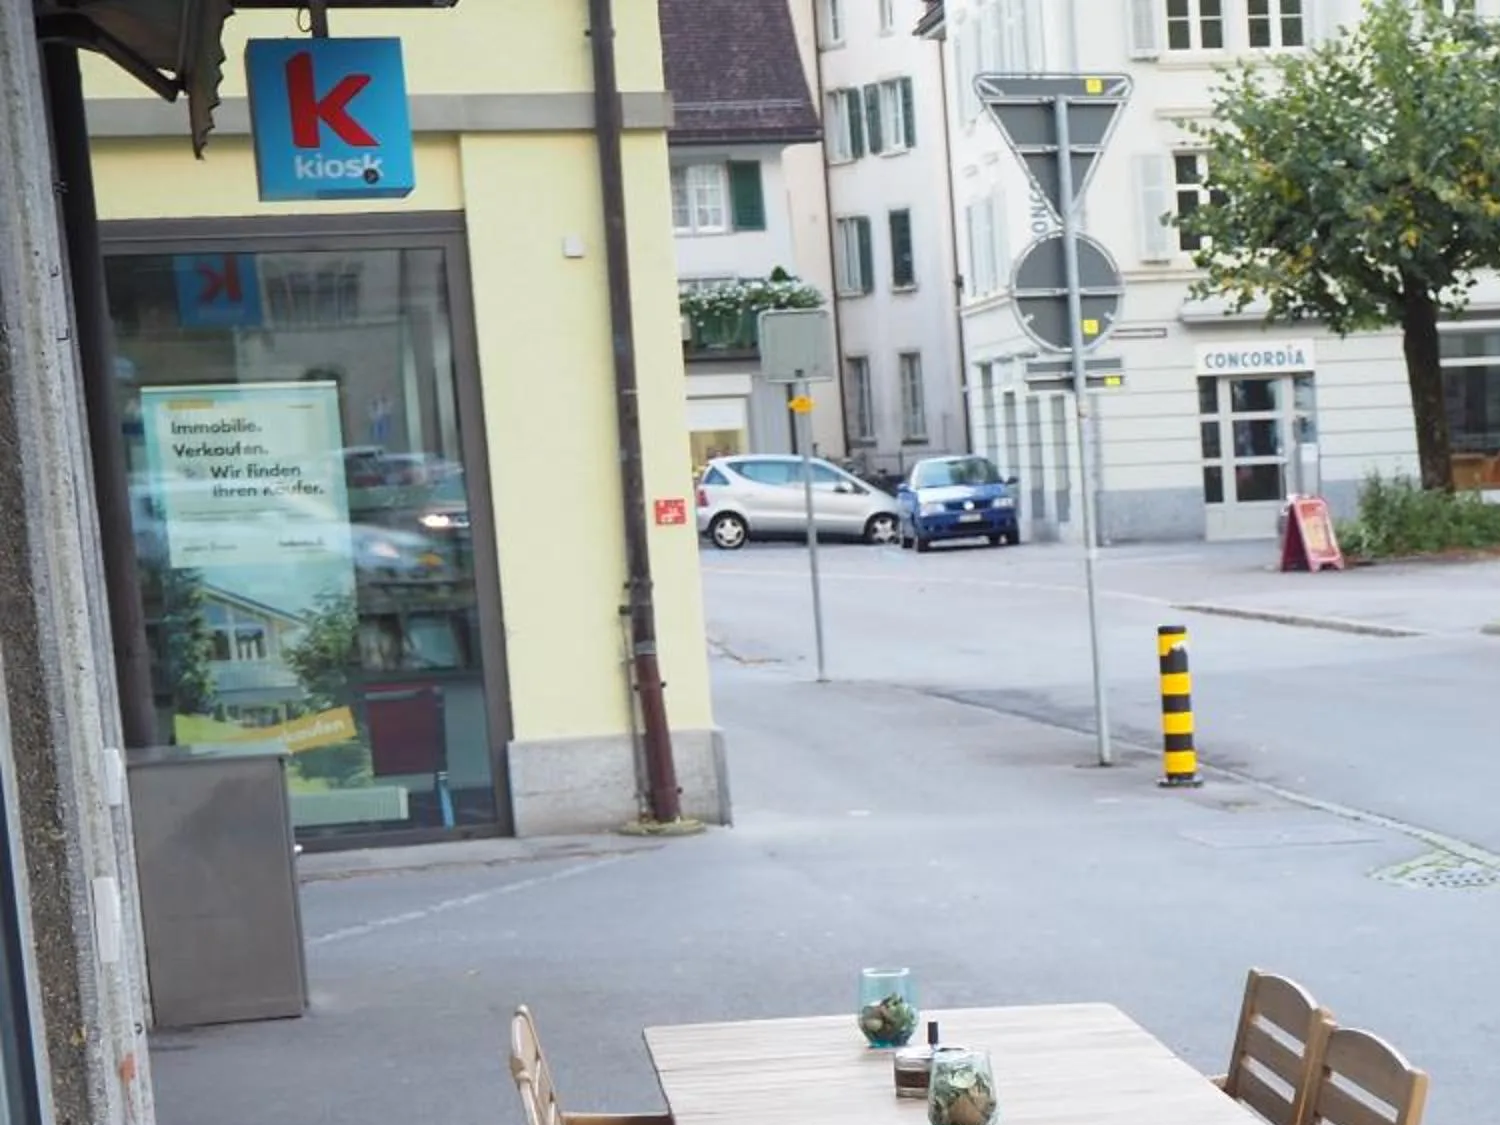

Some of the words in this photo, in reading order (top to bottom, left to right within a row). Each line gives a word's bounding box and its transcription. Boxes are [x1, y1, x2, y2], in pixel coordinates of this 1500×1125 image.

[294, 154, 384, 179] kiosk
[210, 464, 241, 479] Wir
[247, 462, 302, 478] finden
